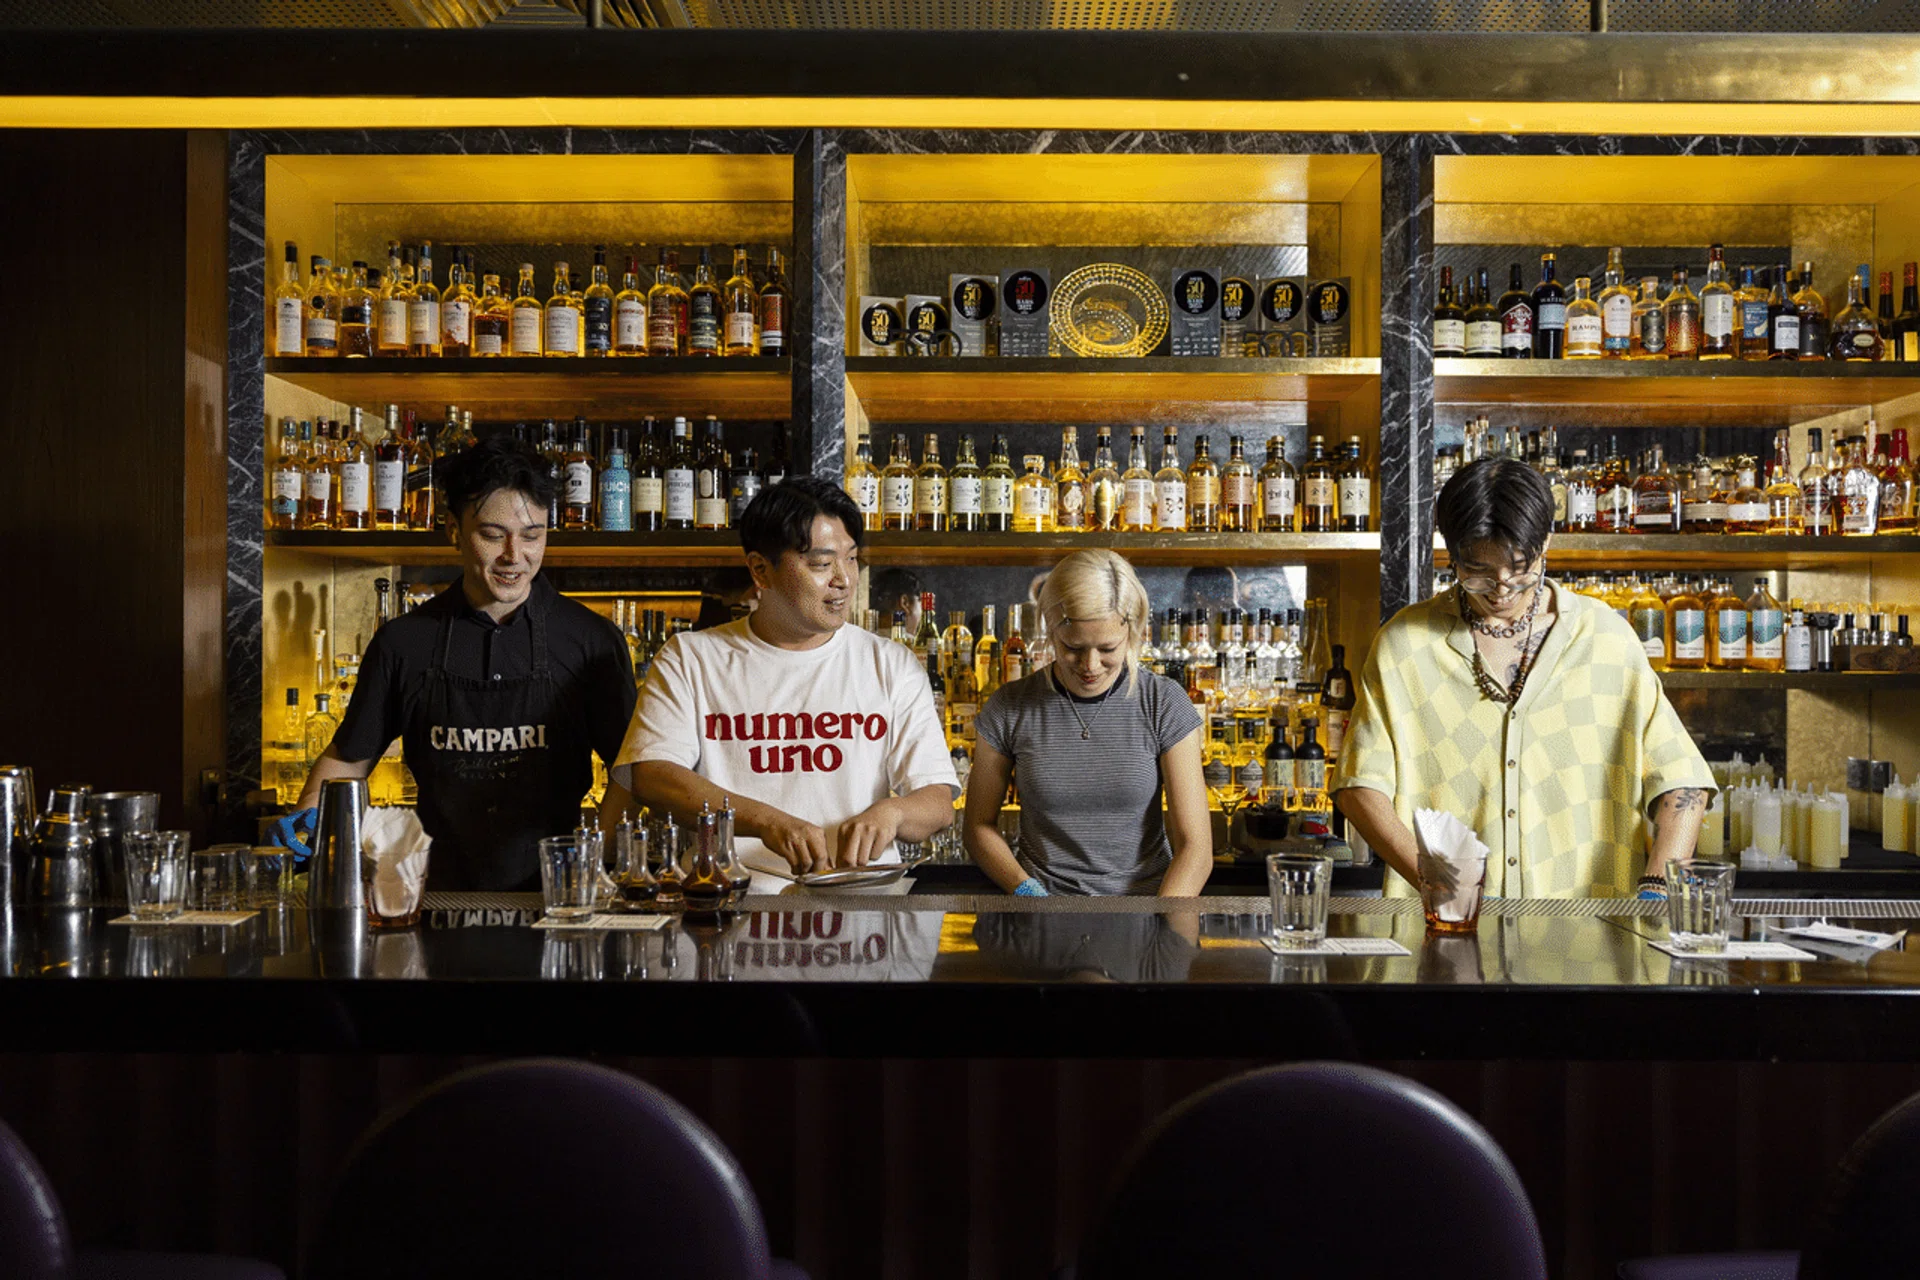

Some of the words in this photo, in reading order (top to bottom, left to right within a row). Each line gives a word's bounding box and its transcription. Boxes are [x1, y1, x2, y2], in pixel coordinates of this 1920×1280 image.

[963, 287, 981, 301] 50
[1015, 280, 1034, 294] 50
[1186, 280, 1205, 294] 50
[1223, 286, 1243, 301] 50
[1273, 288, 1293, 303] 50
[1320, 289, 1339, 304] 50
[872, 312, 889, 326] 50
[918, 311, 936, 325] 50
[705, 712, 888, 741] numero
[430, 725, 545, 752] CAMPARI
[749, 744, 843, 773] uno
